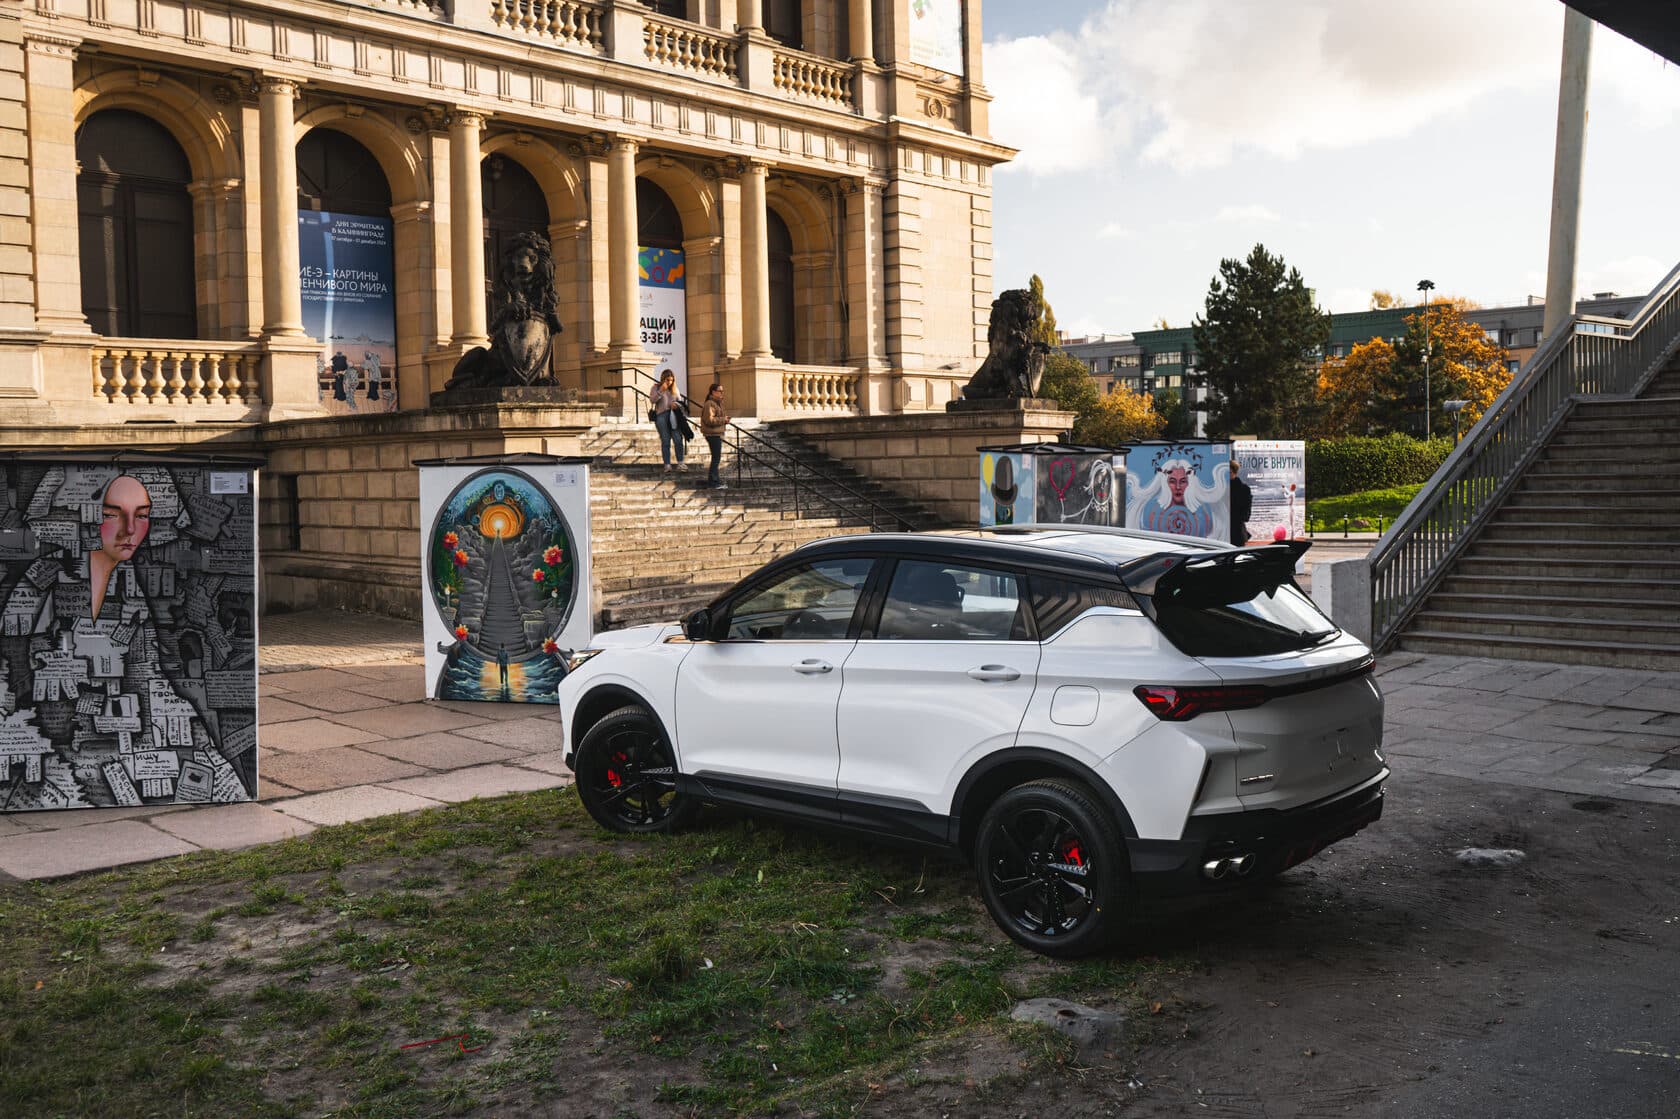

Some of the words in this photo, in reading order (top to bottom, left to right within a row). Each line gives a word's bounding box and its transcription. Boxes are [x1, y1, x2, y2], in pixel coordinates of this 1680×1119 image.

[333, 269, 378, 280] КАРТИНЫ
[300, 278, 358, 291] ЕНЧИВОГО
[360, 282, 387, 292] МИРА
[1271, 456, 1302, 469] ВНУТРИ
